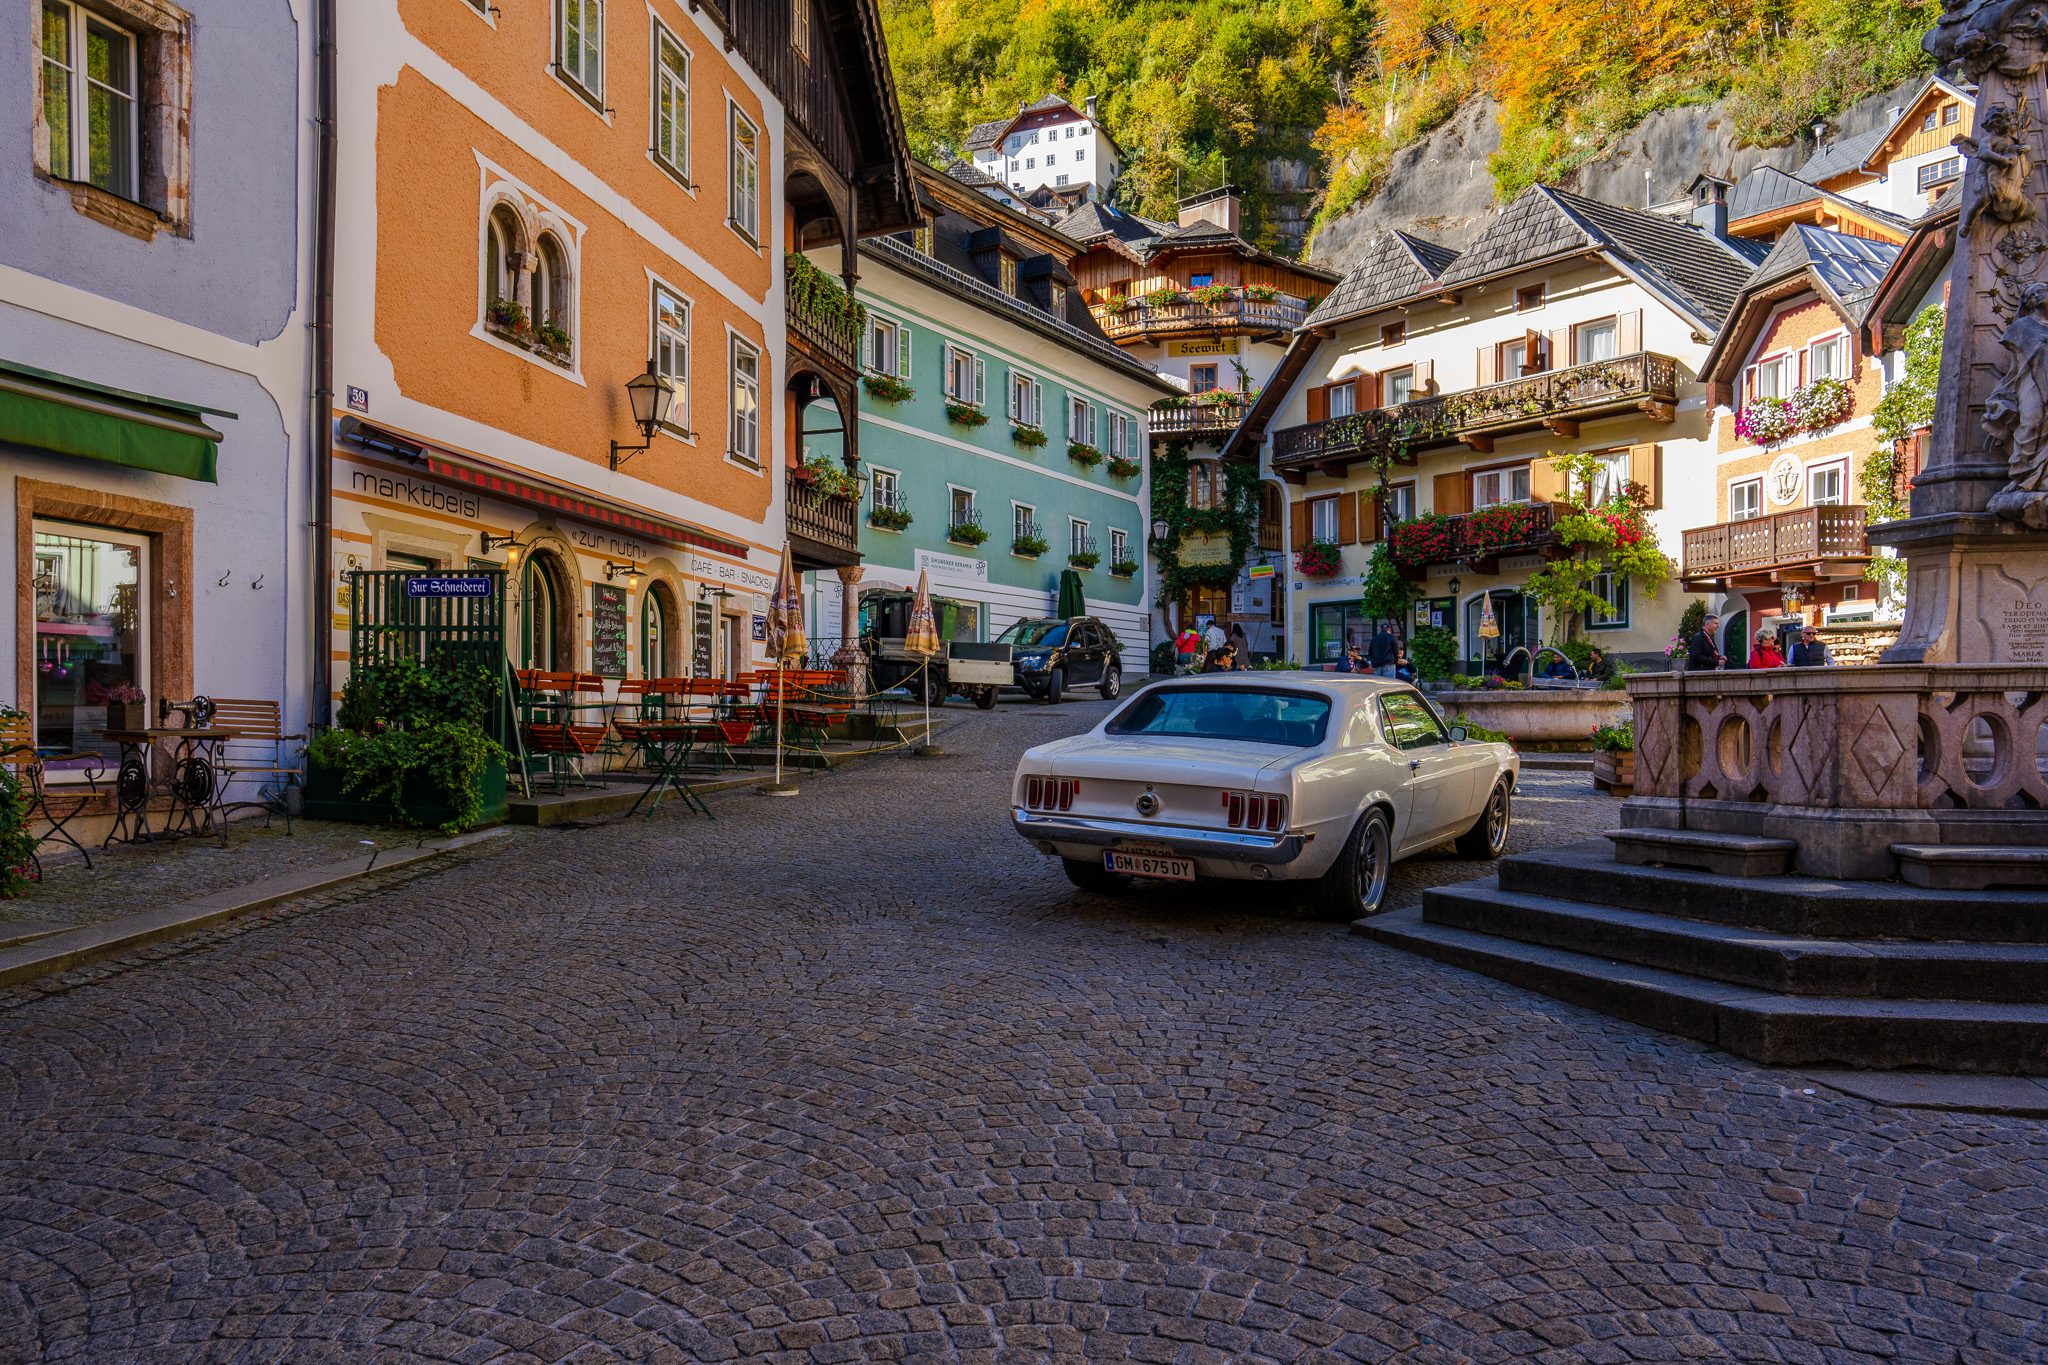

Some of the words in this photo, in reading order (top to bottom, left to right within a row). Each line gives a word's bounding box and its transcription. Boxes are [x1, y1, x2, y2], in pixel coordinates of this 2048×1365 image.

[1181, 342, 1226, 353] Seewirt
[352, 389, 365, 404] 59
[352, 471, 480, 519] marktbeisl
[931, 557, 954, 566] GMUNDNER
[691, 559, 712, 574] CAFÉ
[720, 567, 736, 580] BAR
[411, 580, 427, 593] Zur
[430, 580, 486, 595] Schneiderei
[2015, 600, 2042, 609] DEO
[1116, 856, 1133, 870] GM
